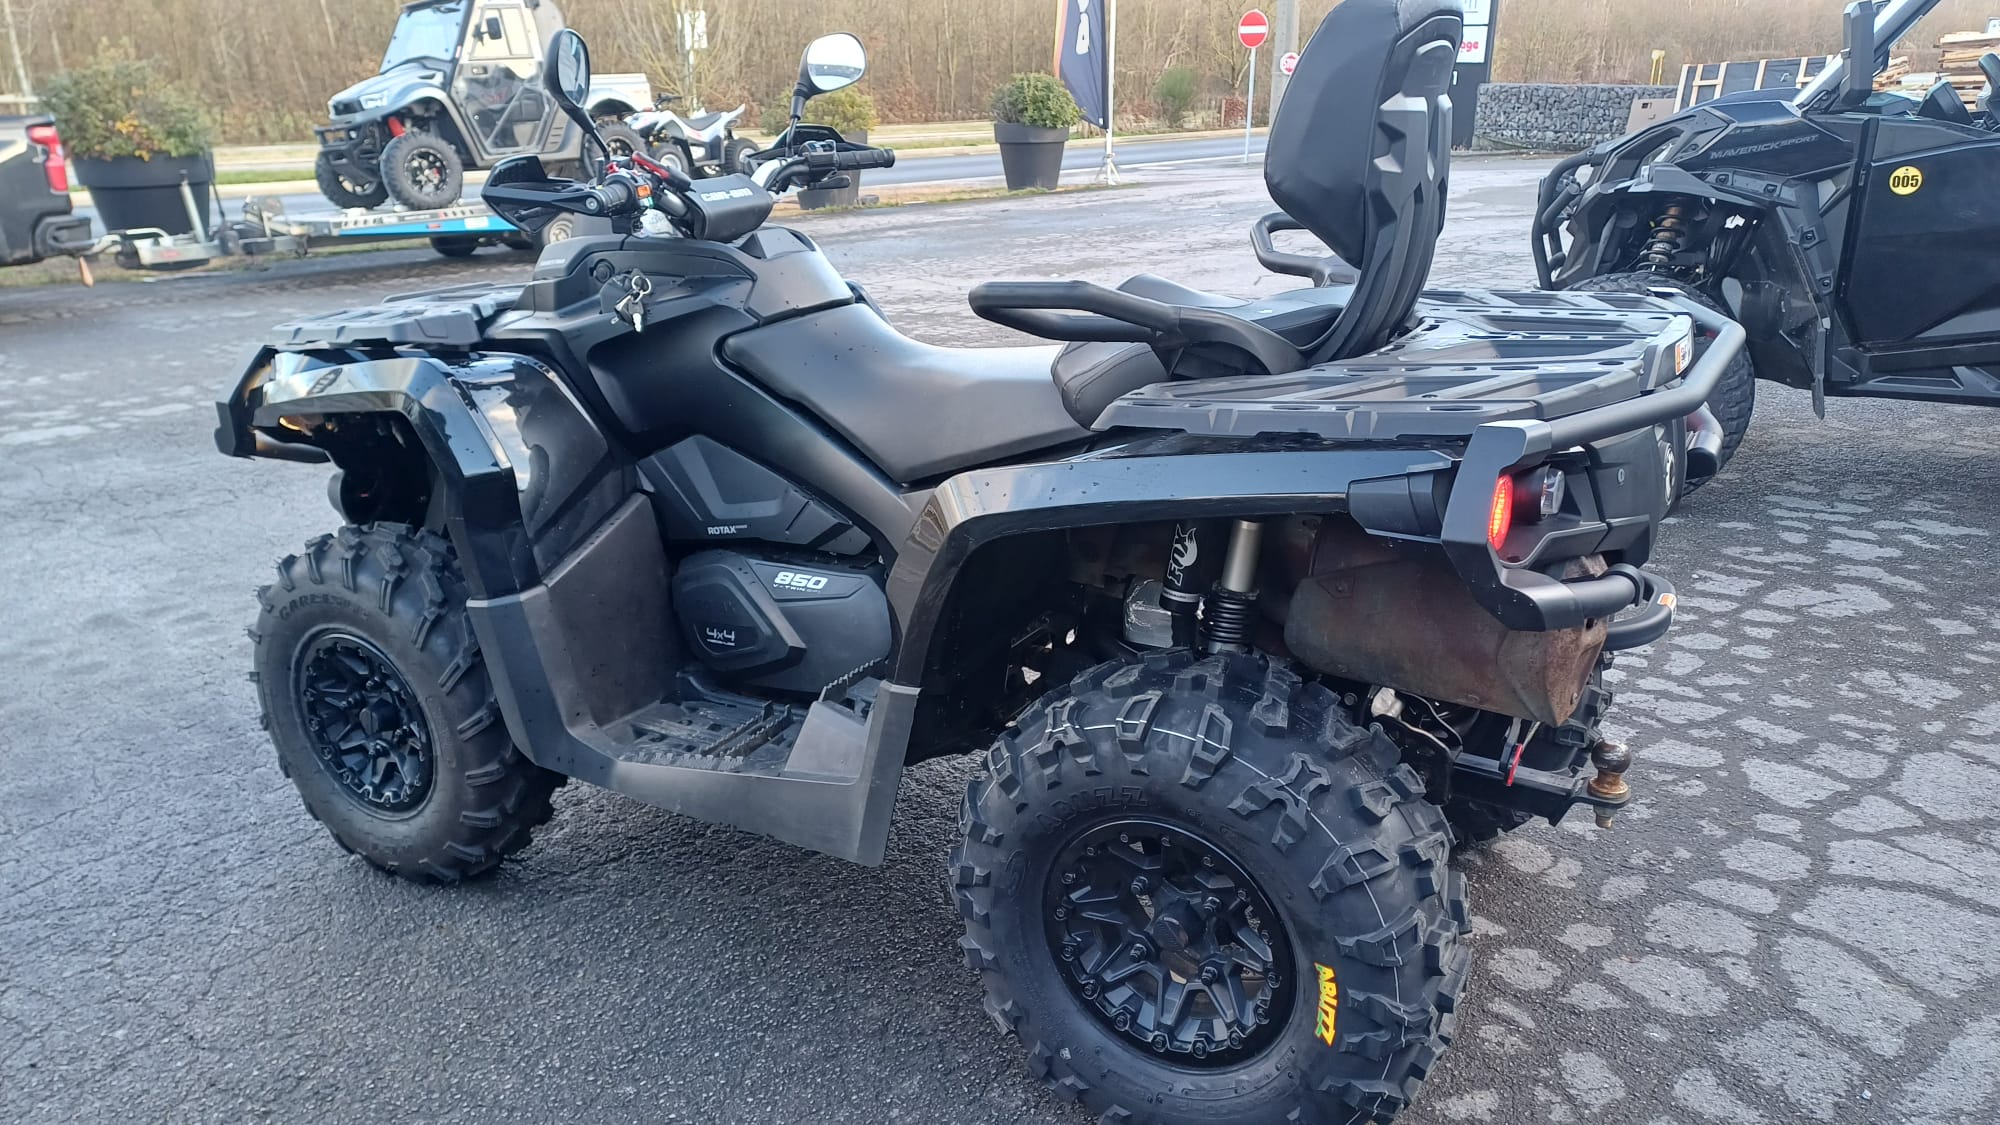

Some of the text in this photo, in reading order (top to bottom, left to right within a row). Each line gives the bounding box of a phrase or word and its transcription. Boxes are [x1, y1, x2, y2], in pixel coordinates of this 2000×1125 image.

[1710, 134, 1819, 159] MAVERICK SPORT
[1892, 175, 1919, 188] 005
[707, 525, 737, 535] ROTAX
[774, 571, 828, 590] 850
[1314, 962, 1338, 1046] ABUZZ
